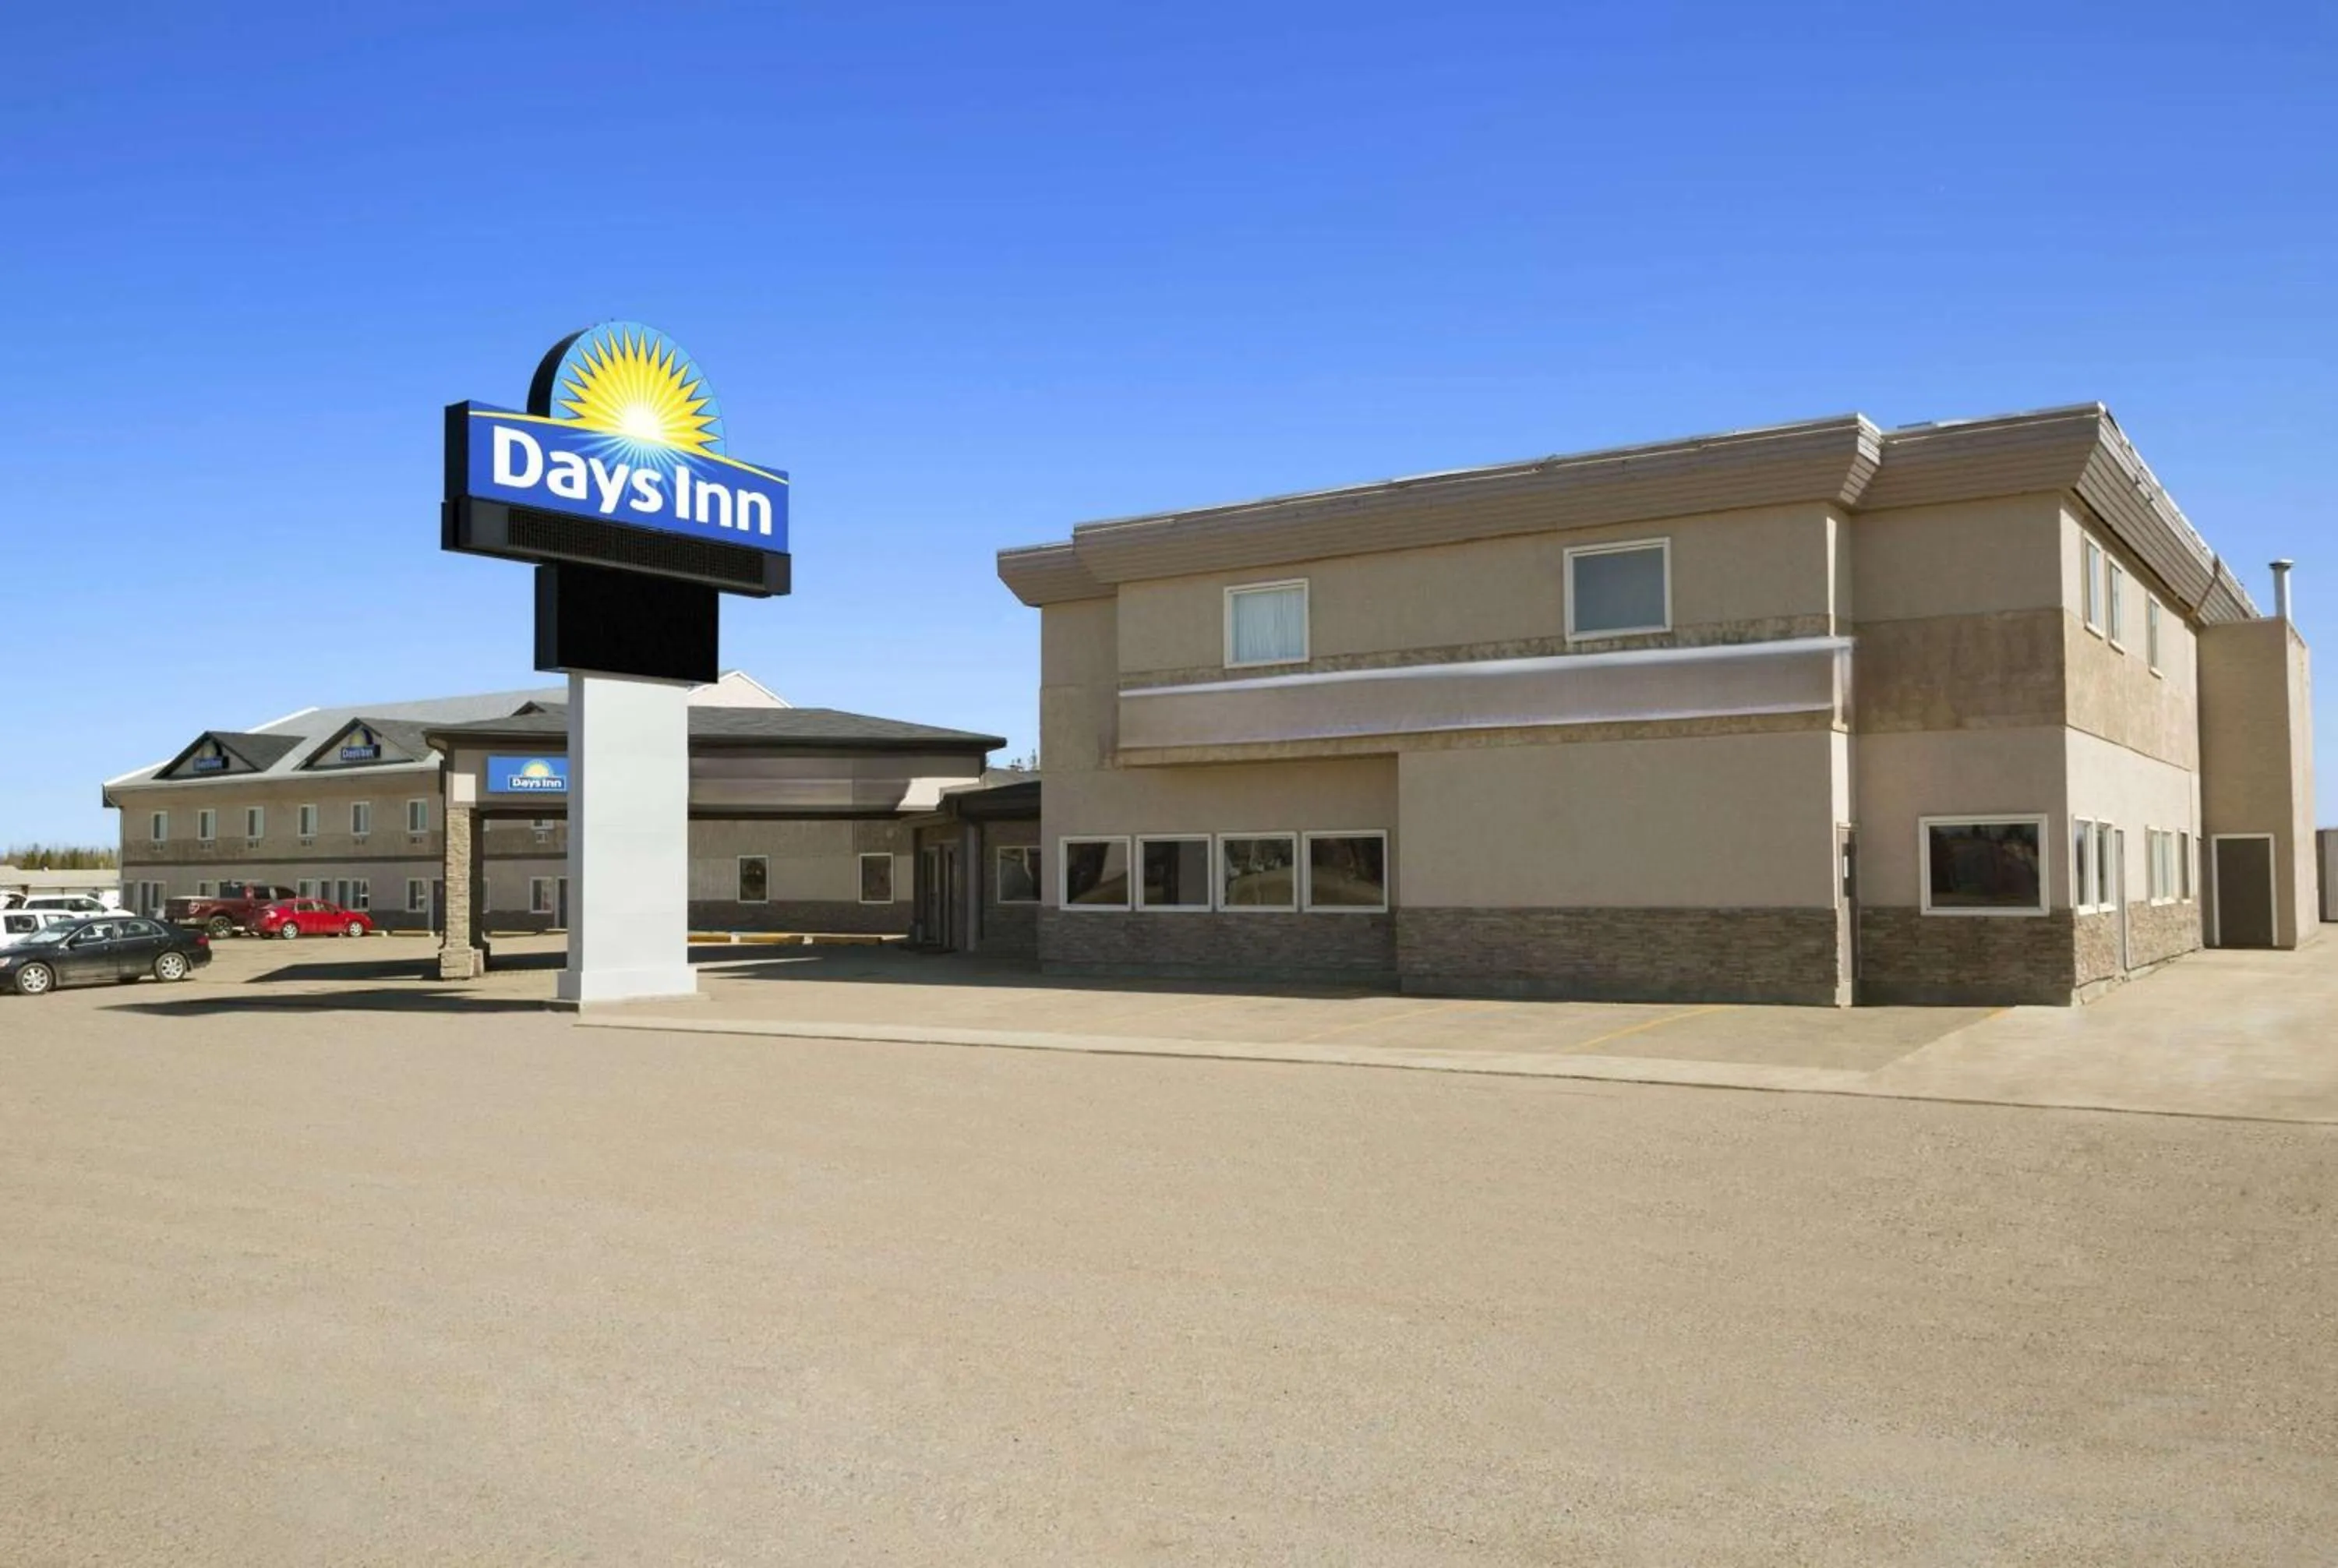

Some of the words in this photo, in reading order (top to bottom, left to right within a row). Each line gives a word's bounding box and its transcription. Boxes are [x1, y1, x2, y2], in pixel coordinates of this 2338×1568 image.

[493, 426, 663, 514] Days
[676, 465, 772, 535] Inn
[512, 778, 540, 788] Days
[542, 779, 562, 788] Inn
